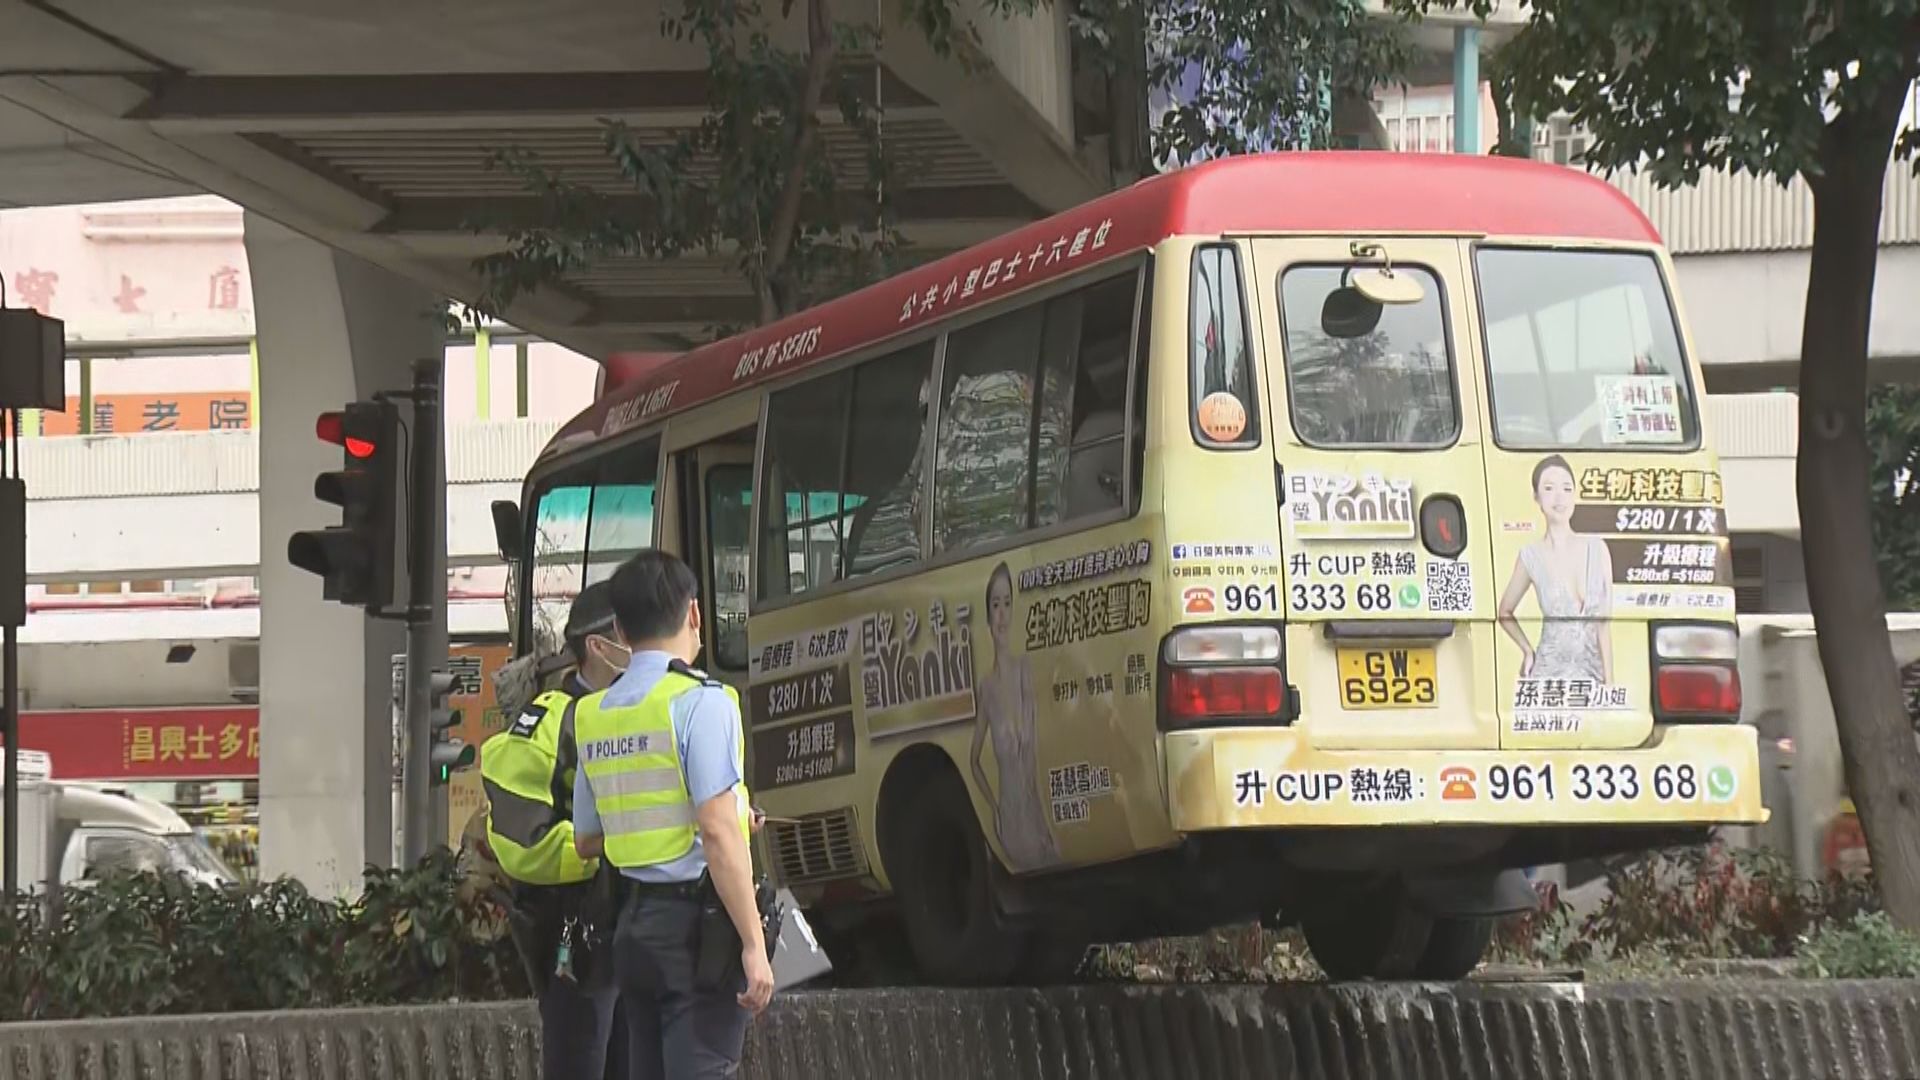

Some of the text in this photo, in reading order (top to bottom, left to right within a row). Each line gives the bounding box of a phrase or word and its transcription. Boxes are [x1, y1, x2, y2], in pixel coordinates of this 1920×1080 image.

[899, 218, 1112, 323] 公共小型巴士十六座位
[733, 326, 823, 381] BUS 16 SEATS
[642, 380, 681, 417] LIGHT
[1312, 491, 1410, 521] Yanki
[1616, 506, 1665, 531] $280
[1290, 551, 1416, 576] 升 CUP 熱線
[1225, 584, 1392, 612] 961 333 68
[880, 626, 972, 708] Yanki
[1365, 652, 1409, 678] GW
[768, 681, 799, 717] $280
[1345, 678, 1435, 704] 6923
[596, 737, 634, 758] POLICE
[1236, 770, 1267, 803] 升
[1276, 773, 1343, 801] CUP
[1488, 764, 1554, 800] 961
[1572, 764, 1640, 800] 333
[1654, 764, 1697, 799] 68
